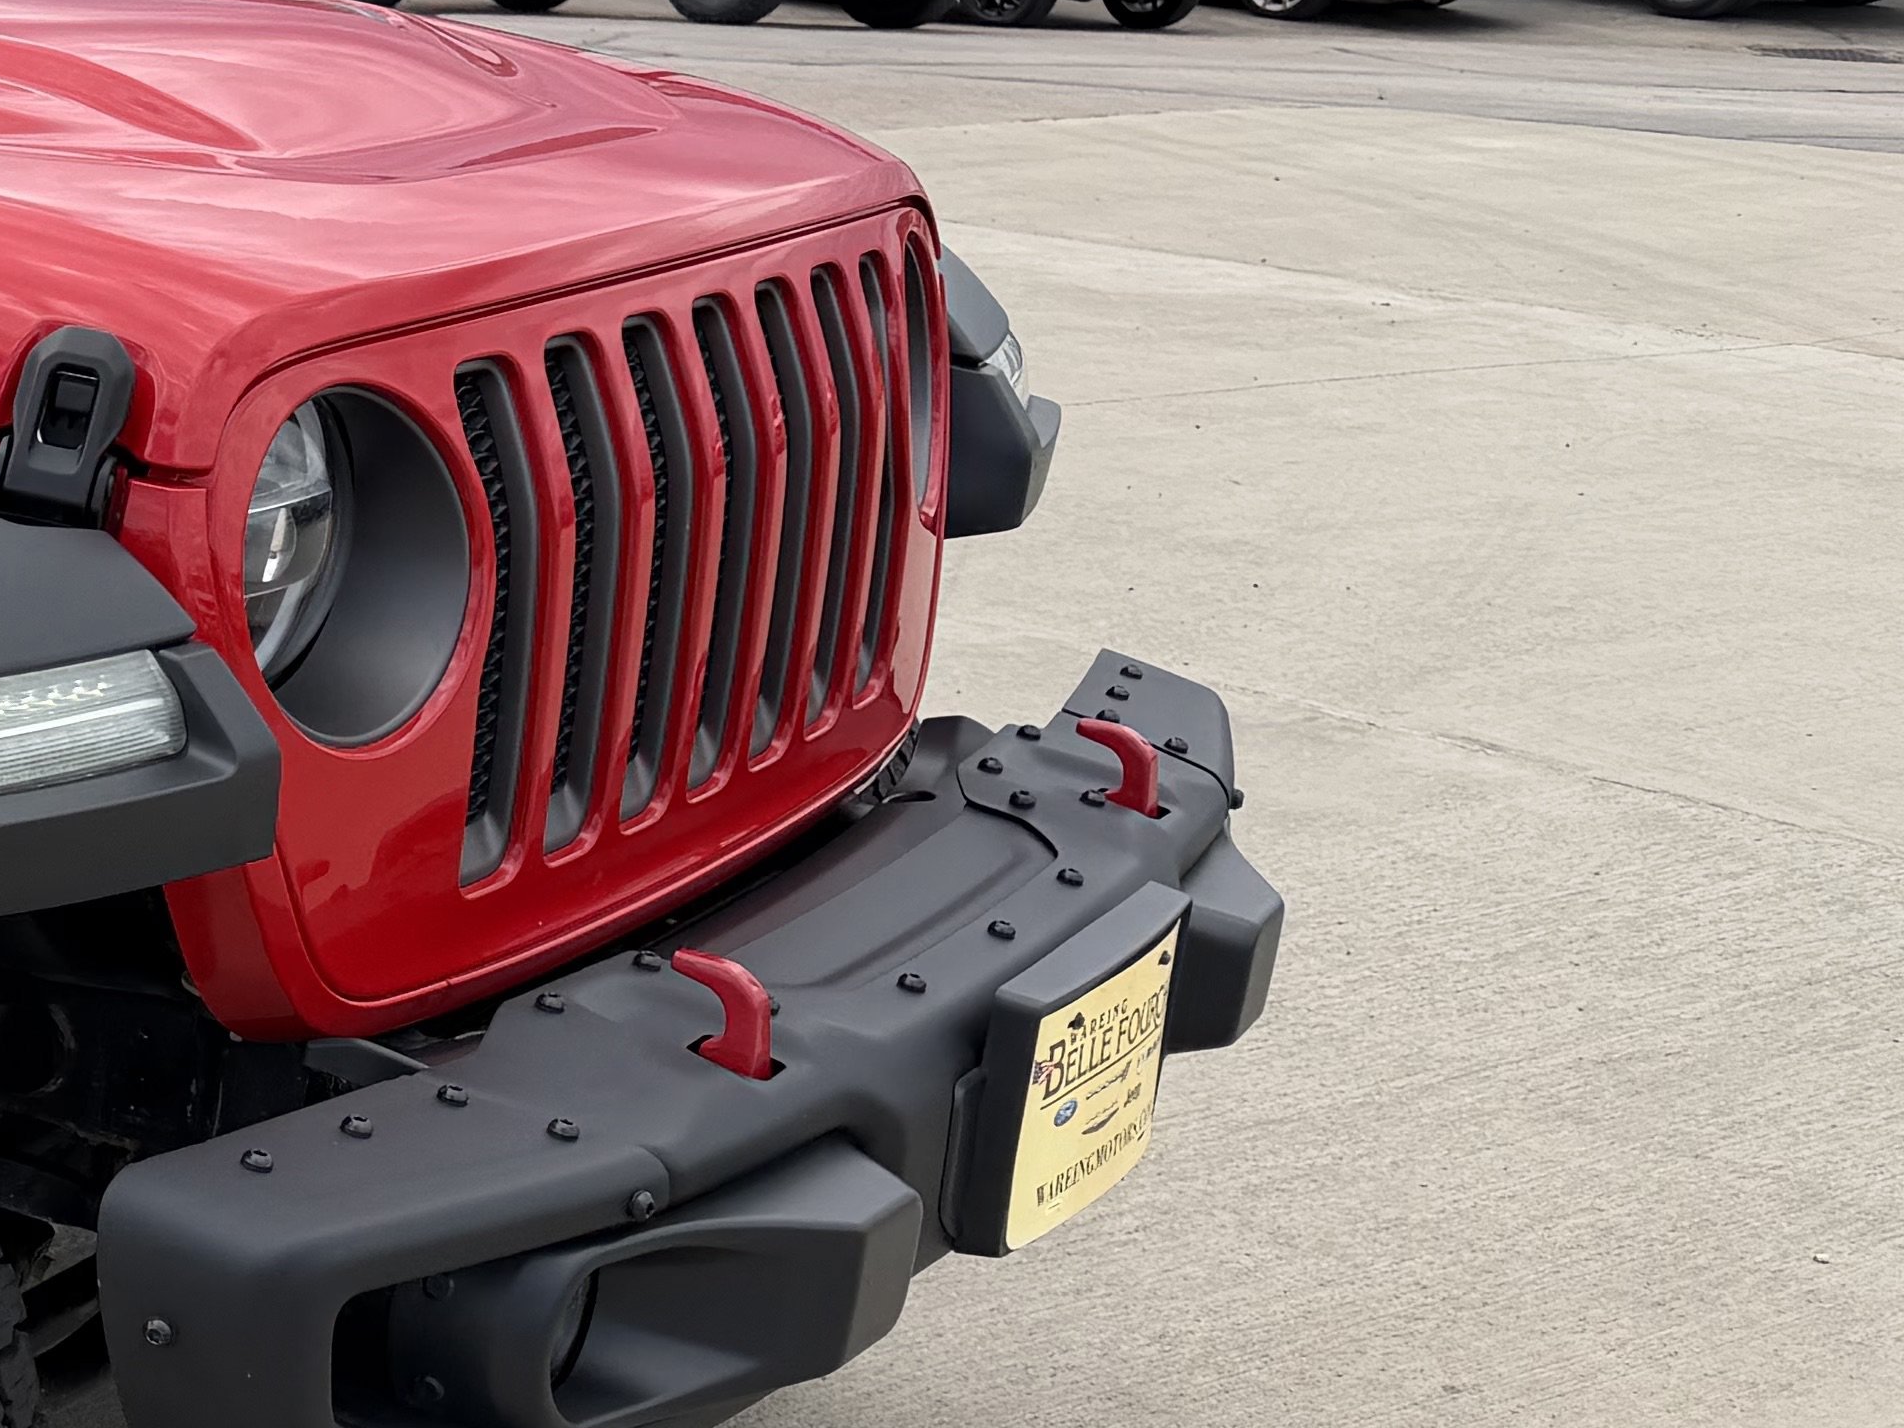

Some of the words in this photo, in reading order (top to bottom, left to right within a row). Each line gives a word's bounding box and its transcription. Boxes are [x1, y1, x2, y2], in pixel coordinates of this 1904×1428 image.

[1043, 1026, 1113, 1101] BELLE
[1115, 980, 1169, 1055] FOURC
[1070, 997, 1128, 1046] WAREING
